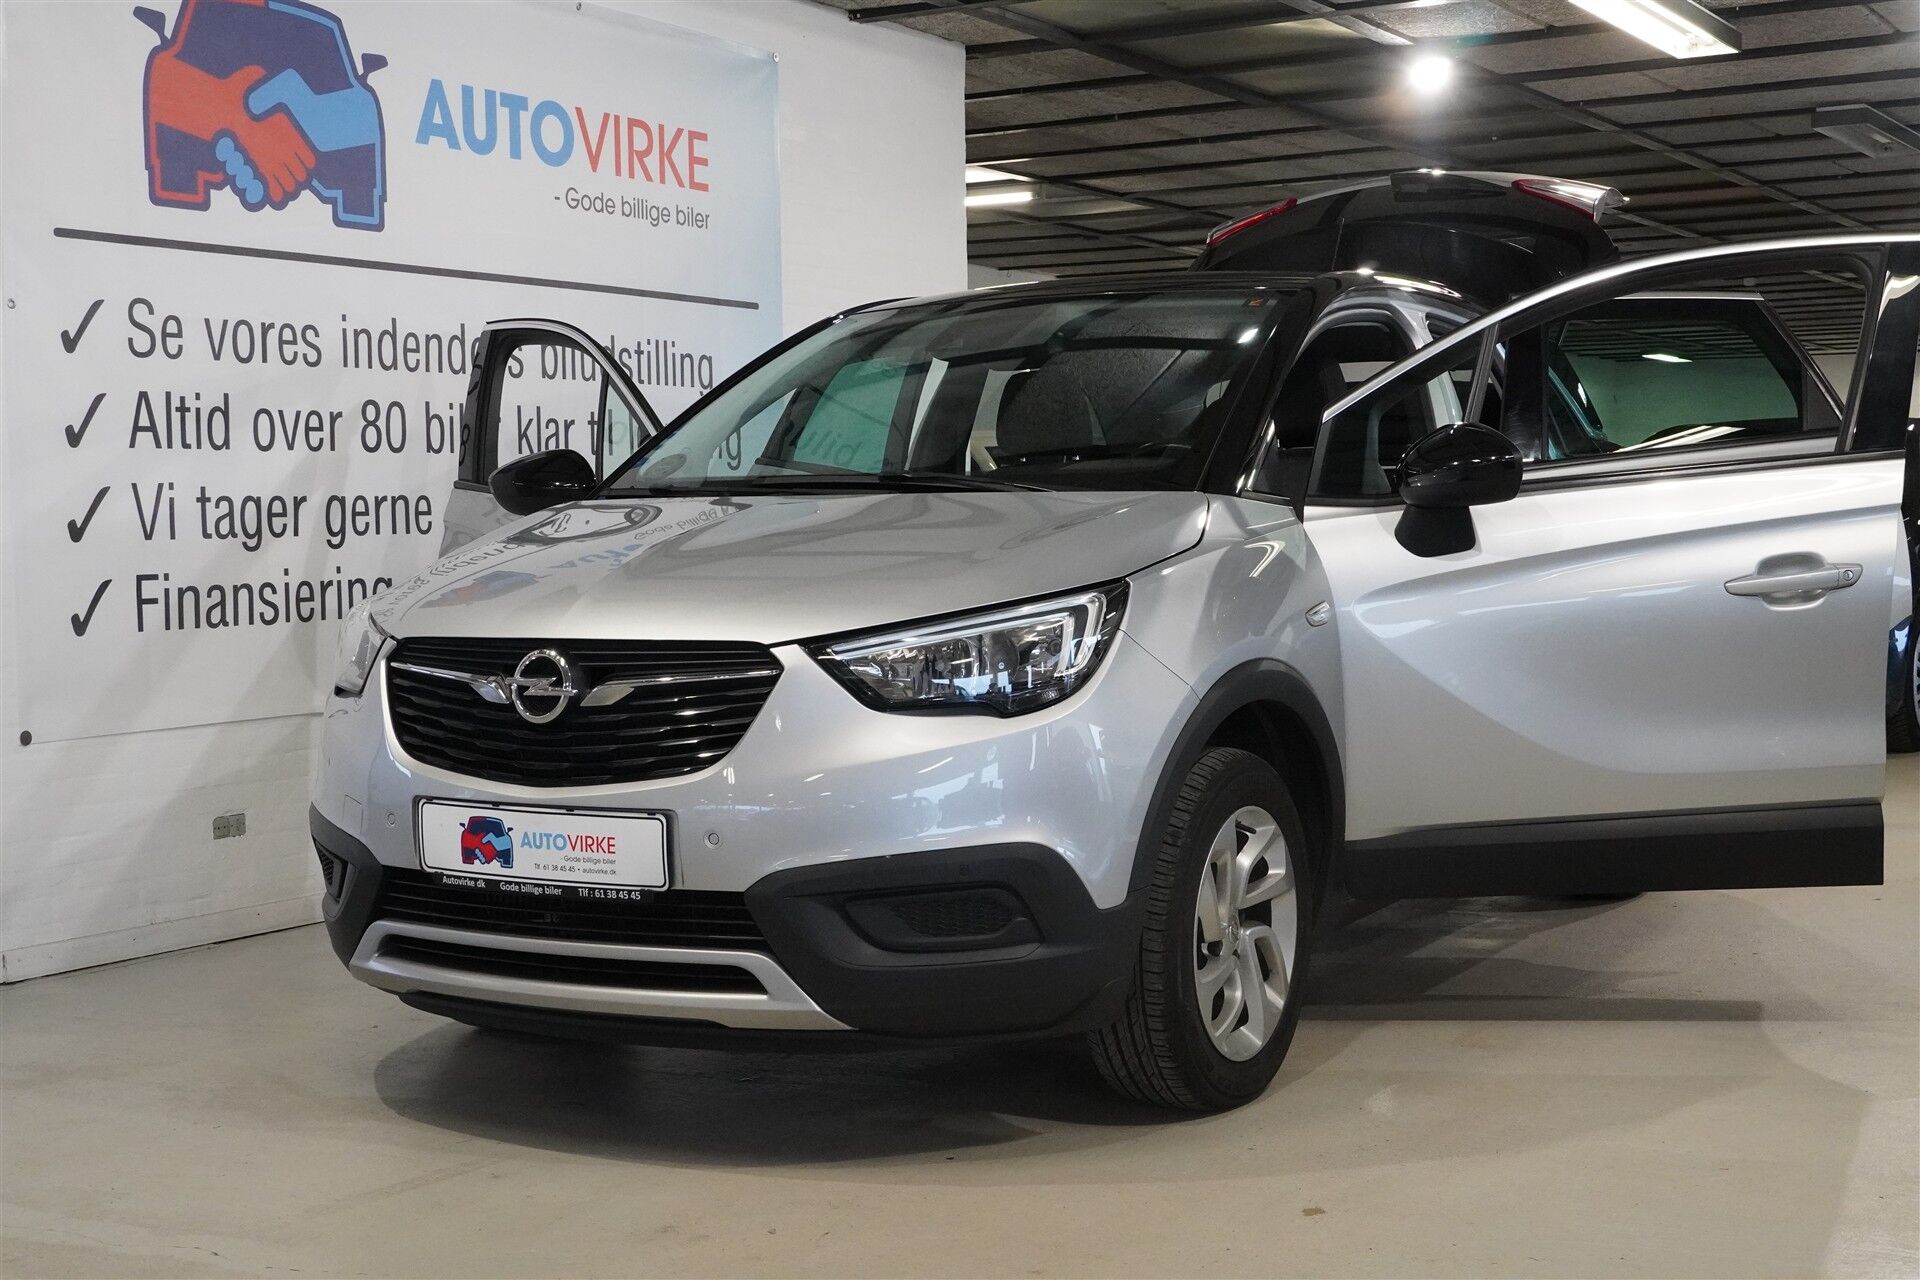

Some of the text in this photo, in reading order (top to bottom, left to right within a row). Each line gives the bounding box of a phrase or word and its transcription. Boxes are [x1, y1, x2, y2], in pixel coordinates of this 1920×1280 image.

[416, 79, 709, 192] AUTOVIRKE
[565, 187, 616, 216] Gode
[621, 196, 671, 227] billige
[676, 205, 710, 230] biler
[128, 297, 184, 360] Se
[204, 317, 323, 368] vores
[129, 390, 231, 452] Altid
[253, 407, 344, 453] over
[361, 398, 407, 454] 80
[516, 404, 576, 456] klar
[131, 482, 433, 552] Vi tager gerne
[520, 832, 616, 854] AUTOVIRKE
[564, 855, 581, 863] Gode
[583, 857, 602, 866] billige
[442, 875, 475, 887] Autovirke
[500, 882, 520, 892] Gode
[521, 884, 543, 895] billige
[544, 886, 562, 896] biler
[595, 889, 605, 898] 61
[606, 890, 616, 899] 38
[618, 891, 628, 899] 45
[630, 891, 641, 900] 45
